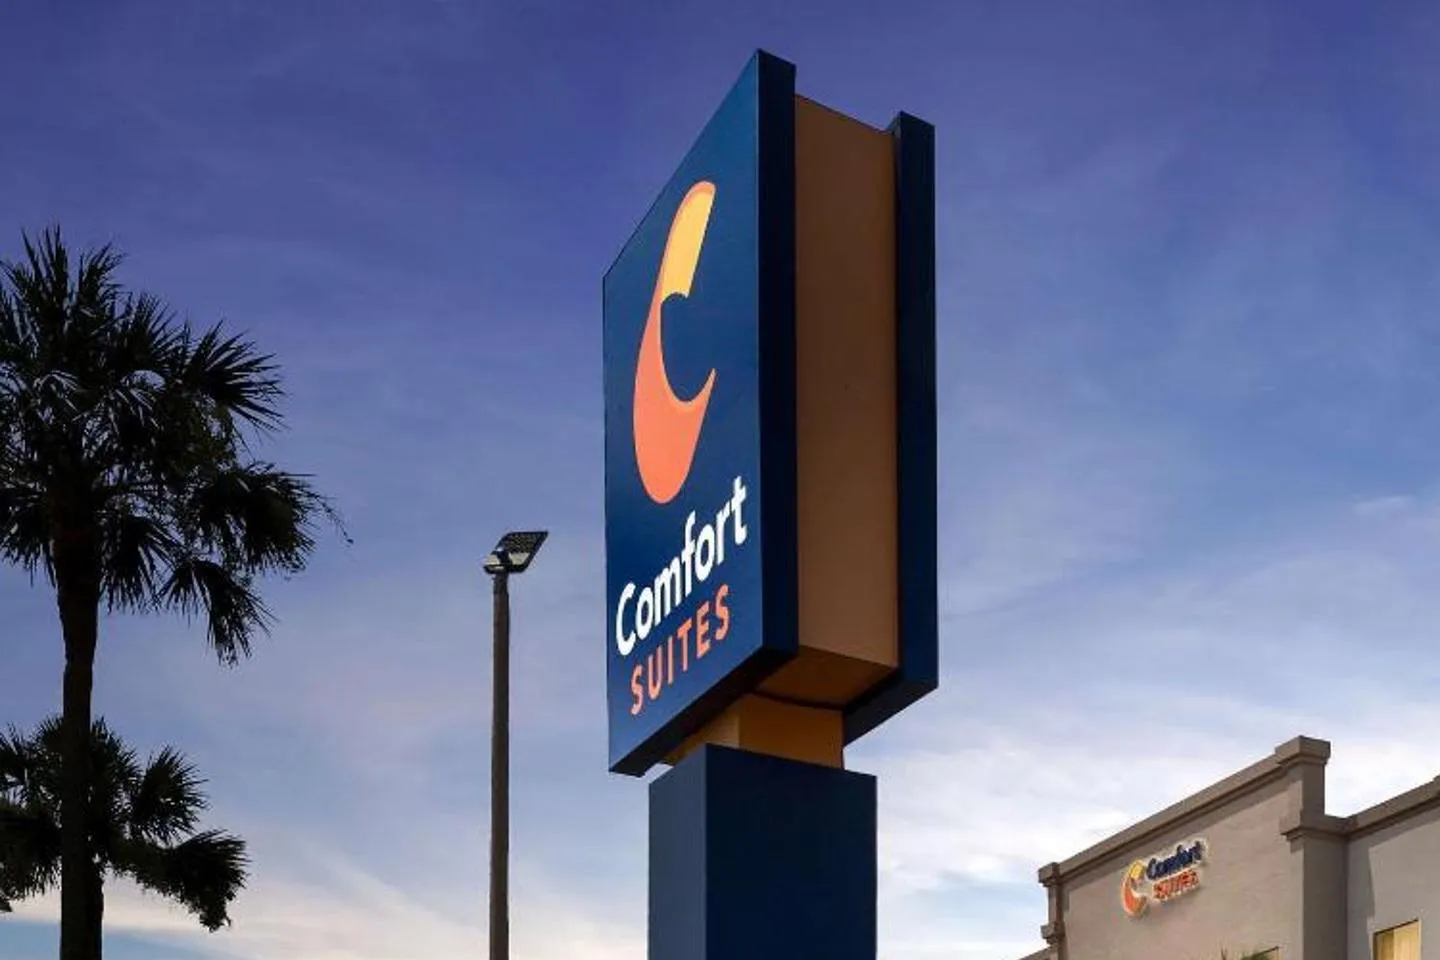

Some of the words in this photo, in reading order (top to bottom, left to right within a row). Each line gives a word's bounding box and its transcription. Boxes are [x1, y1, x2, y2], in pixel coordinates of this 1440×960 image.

[616, 475, 747, 656] Comfort
[630, 584, 730, 715] SUITES
[1146, 840, 1202, 880] Comfort
